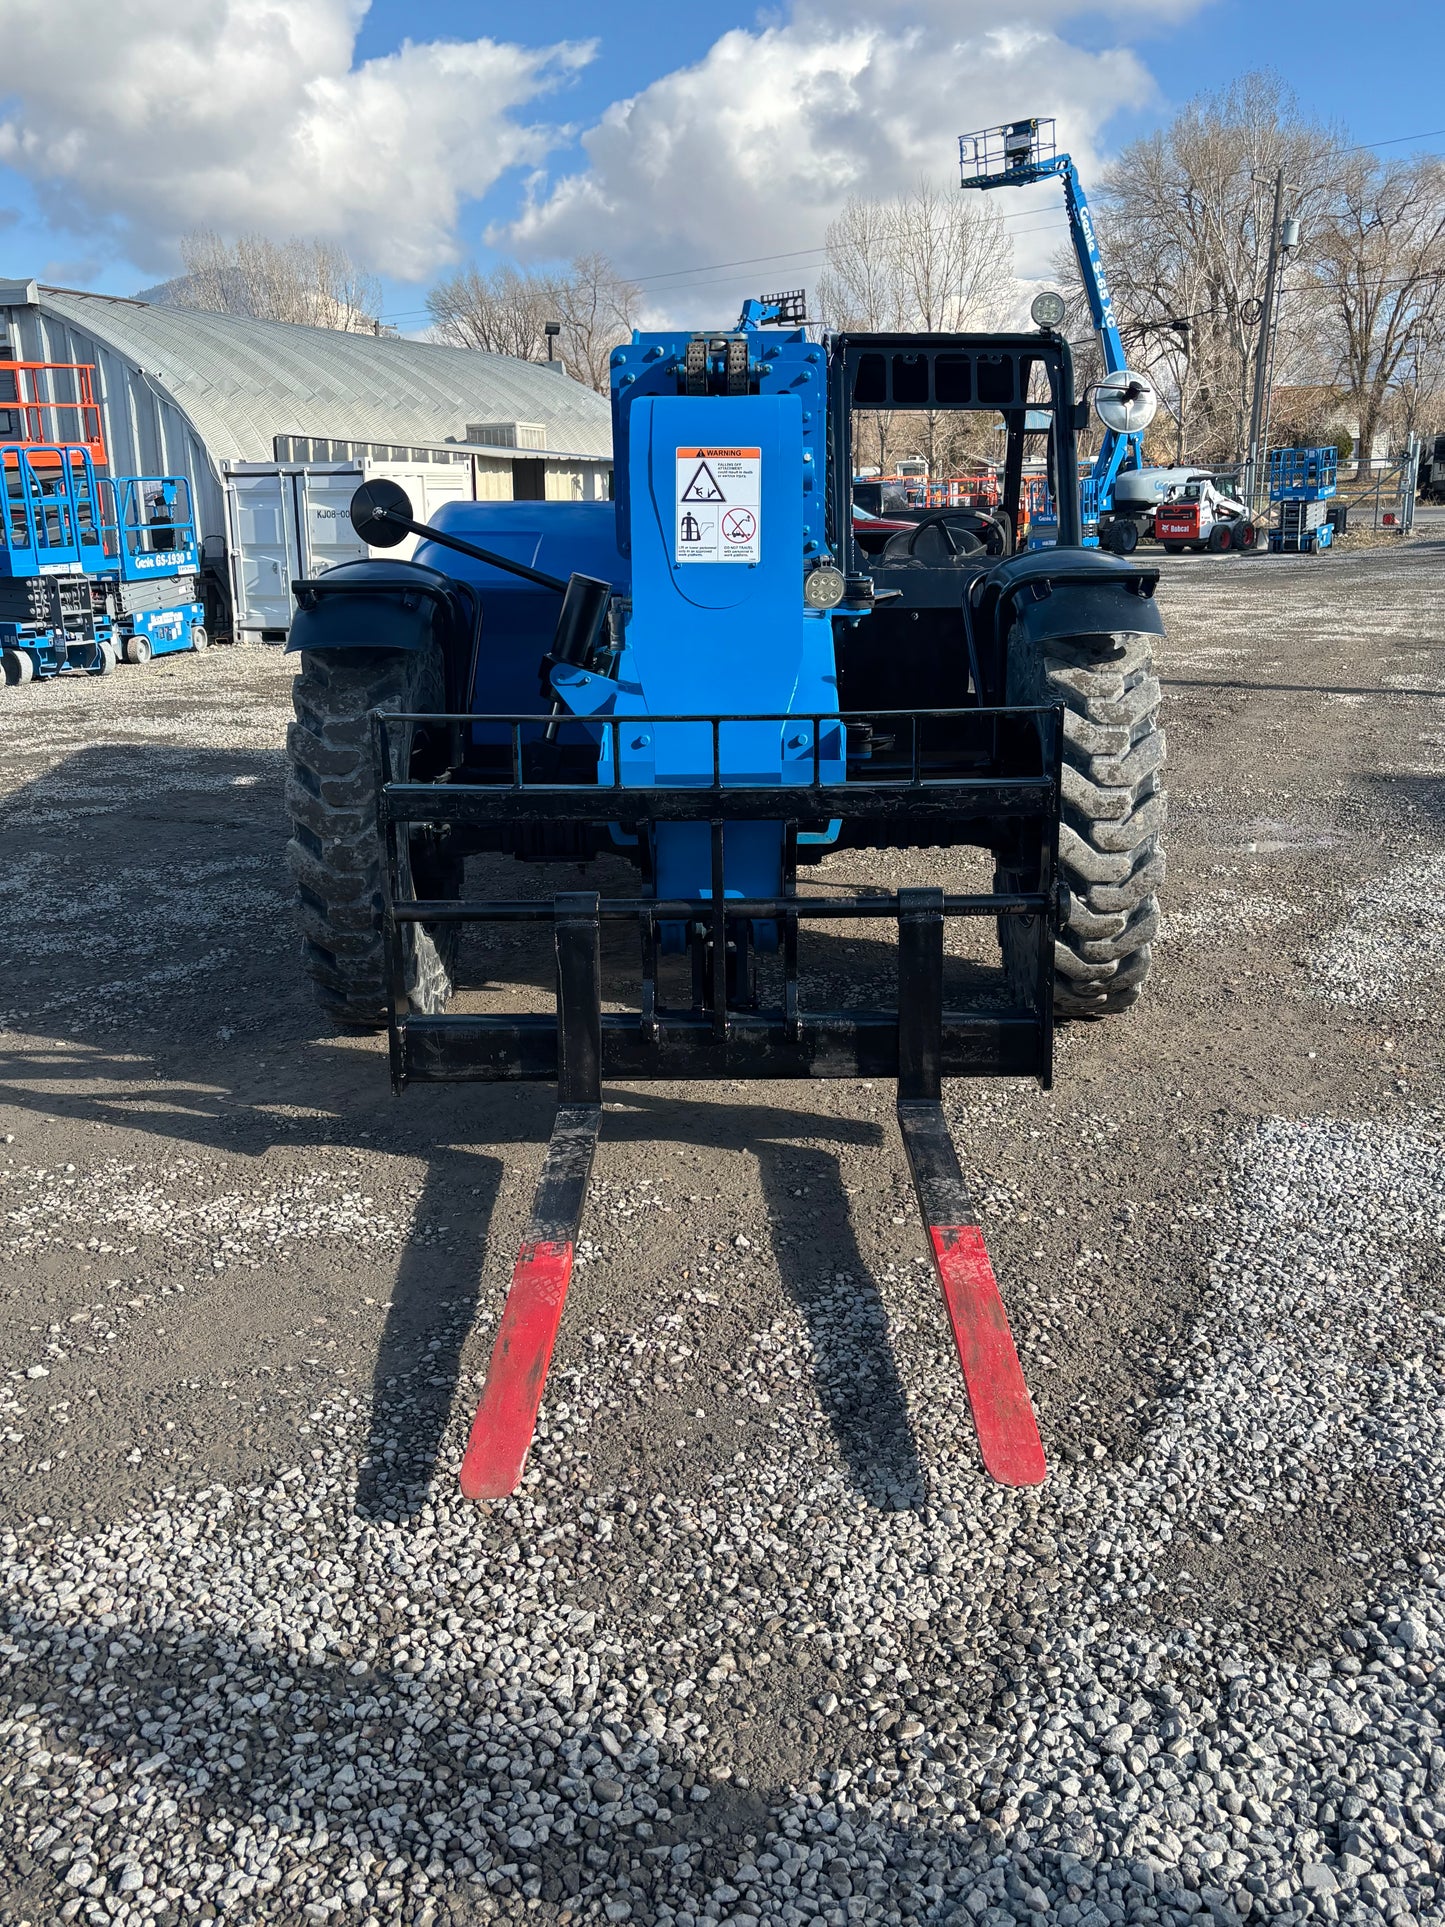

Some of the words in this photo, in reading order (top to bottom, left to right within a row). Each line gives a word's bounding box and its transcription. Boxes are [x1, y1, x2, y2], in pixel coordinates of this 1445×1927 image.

[1080, 206, 1096, 253] Genie
[1092, 260, 1110, 300] S-65
[1103, 304, 1116, 329] XC
[706, 449, 742, 457] WARNING
[1170, 525, 1190, 533] Bobcat
[135, 557, 155, 569] Genie
[155, 552, 185, 567] GS-1930
